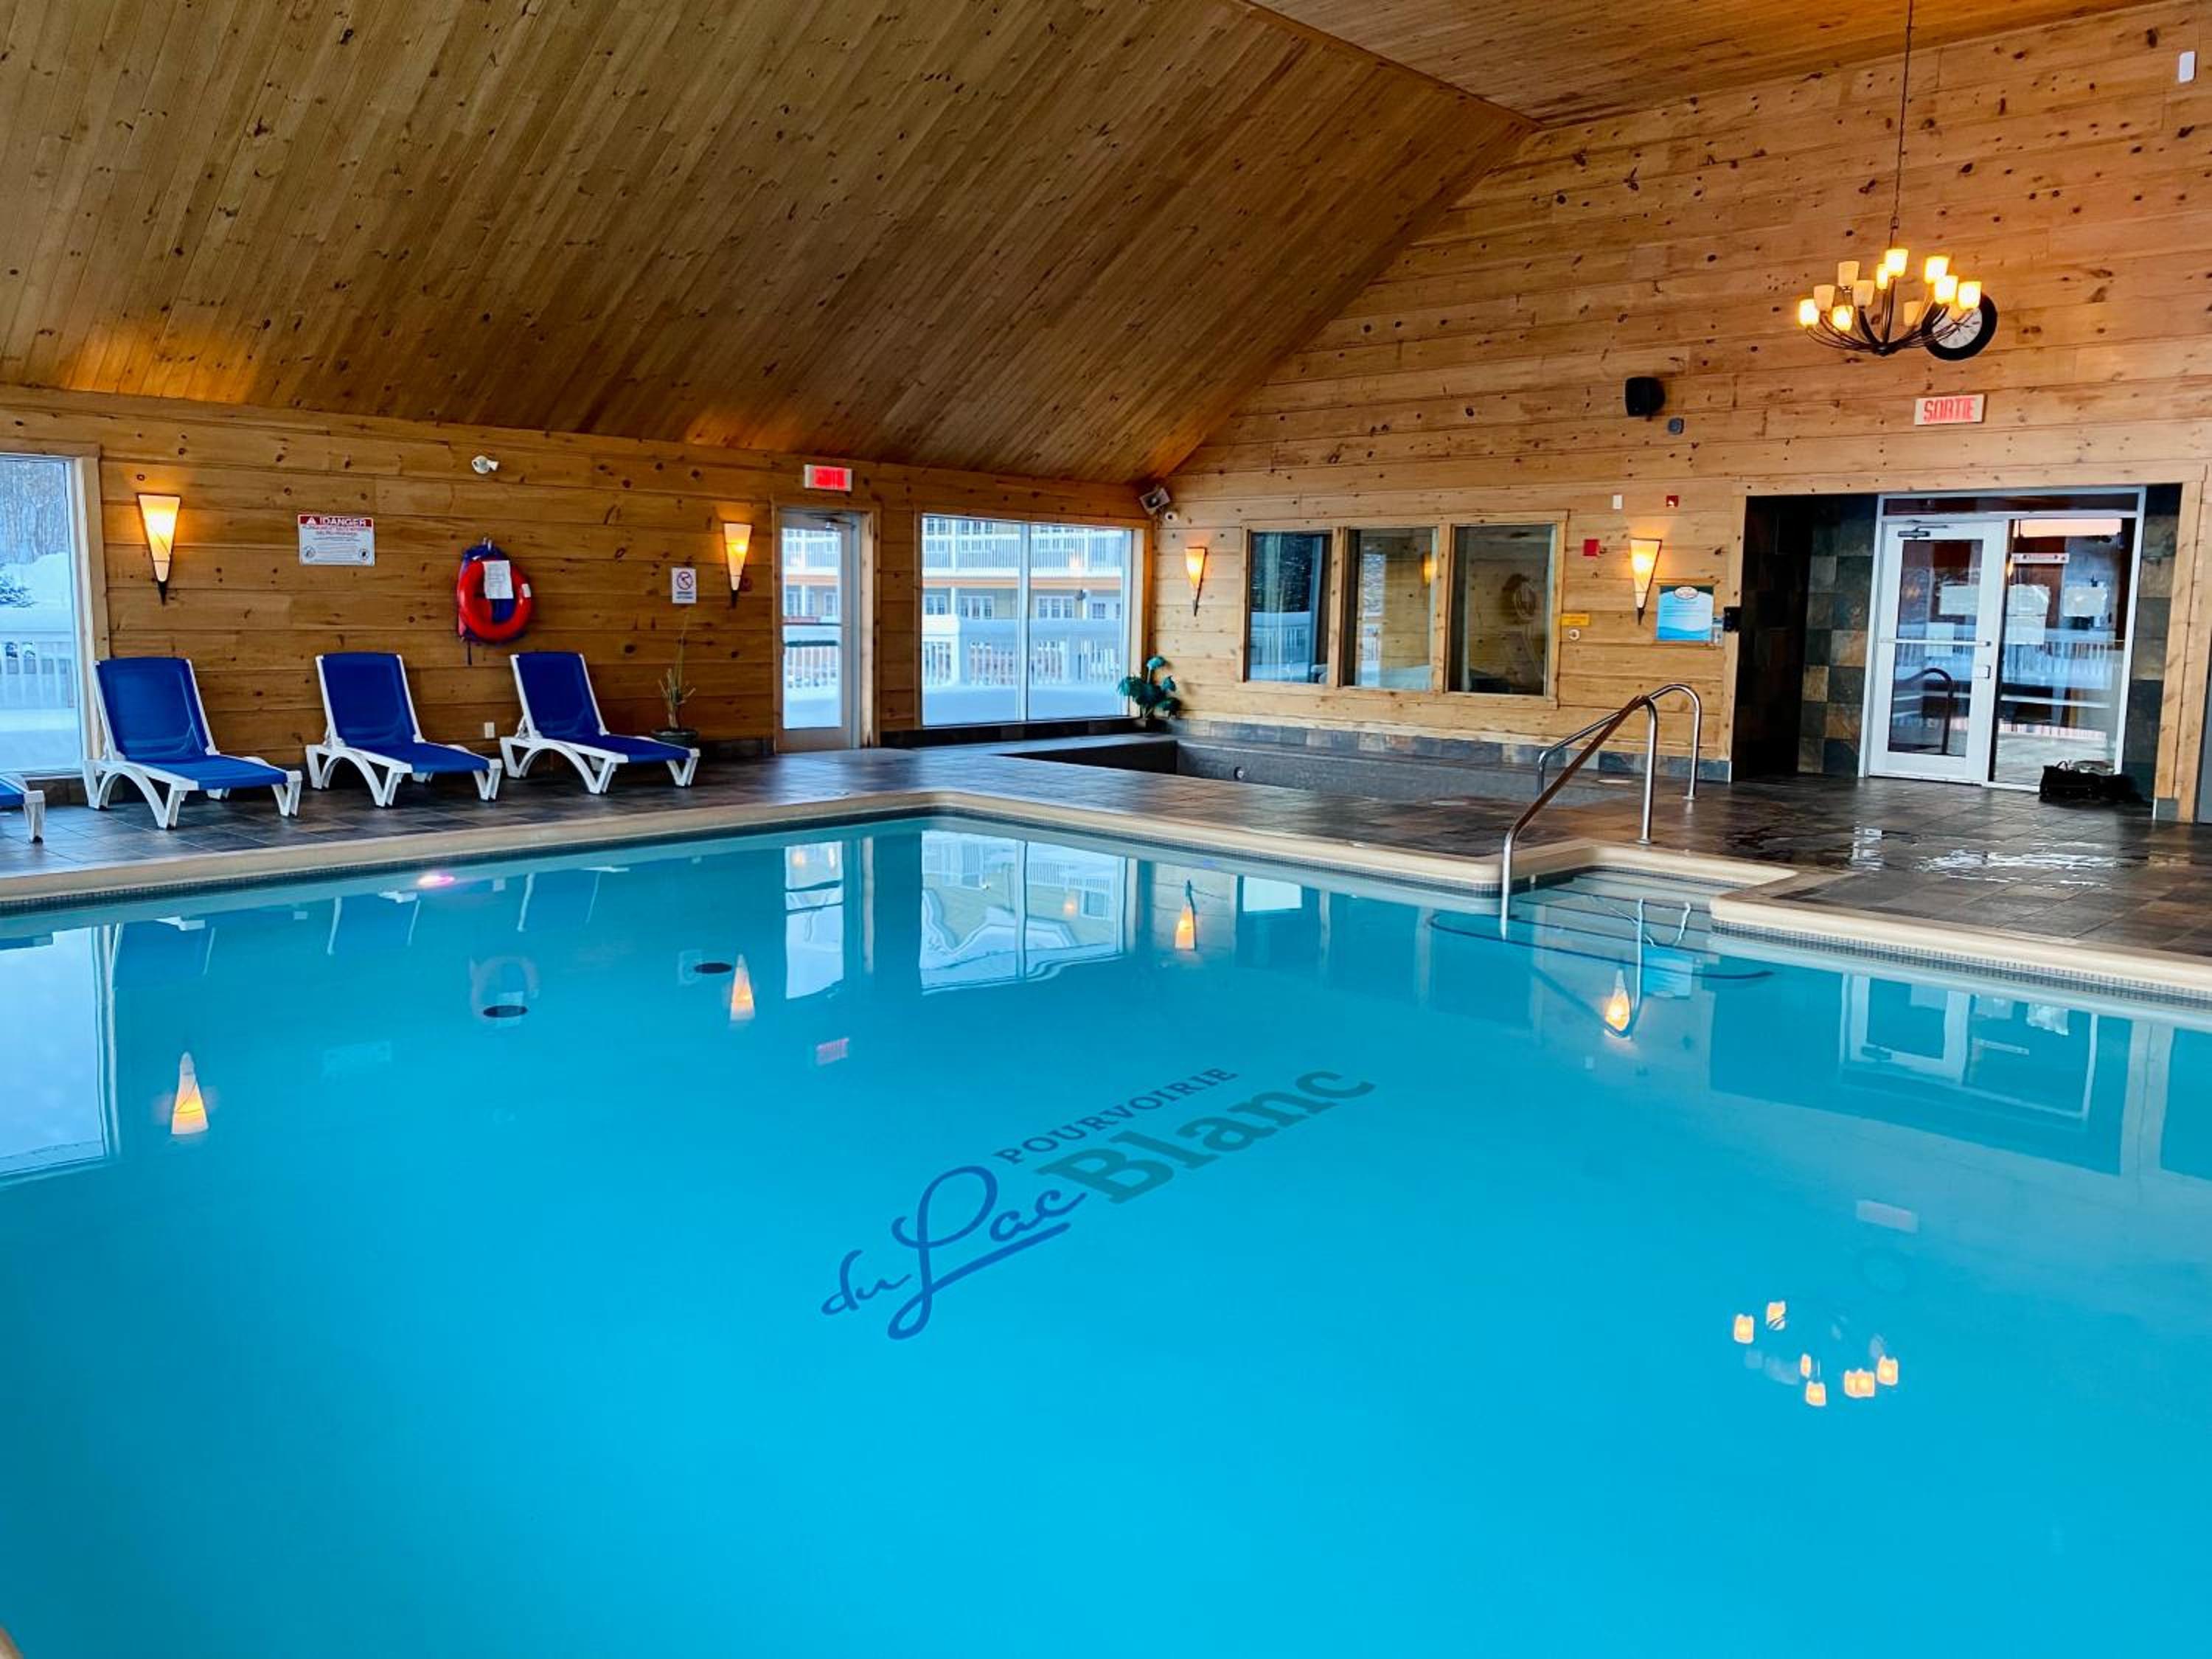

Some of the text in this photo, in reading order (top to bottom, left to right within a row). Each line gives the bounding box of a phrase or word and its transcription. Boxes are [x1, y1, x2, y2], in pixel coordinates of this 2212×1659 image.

[1924, 397, 1975, 422] SORTIE
[323, 517, 366, 527] DANGER
[993, 1068, 1239, 1164] POURVOIRIE
[821, 1071, 1376, 1340] du Lac Blanc
